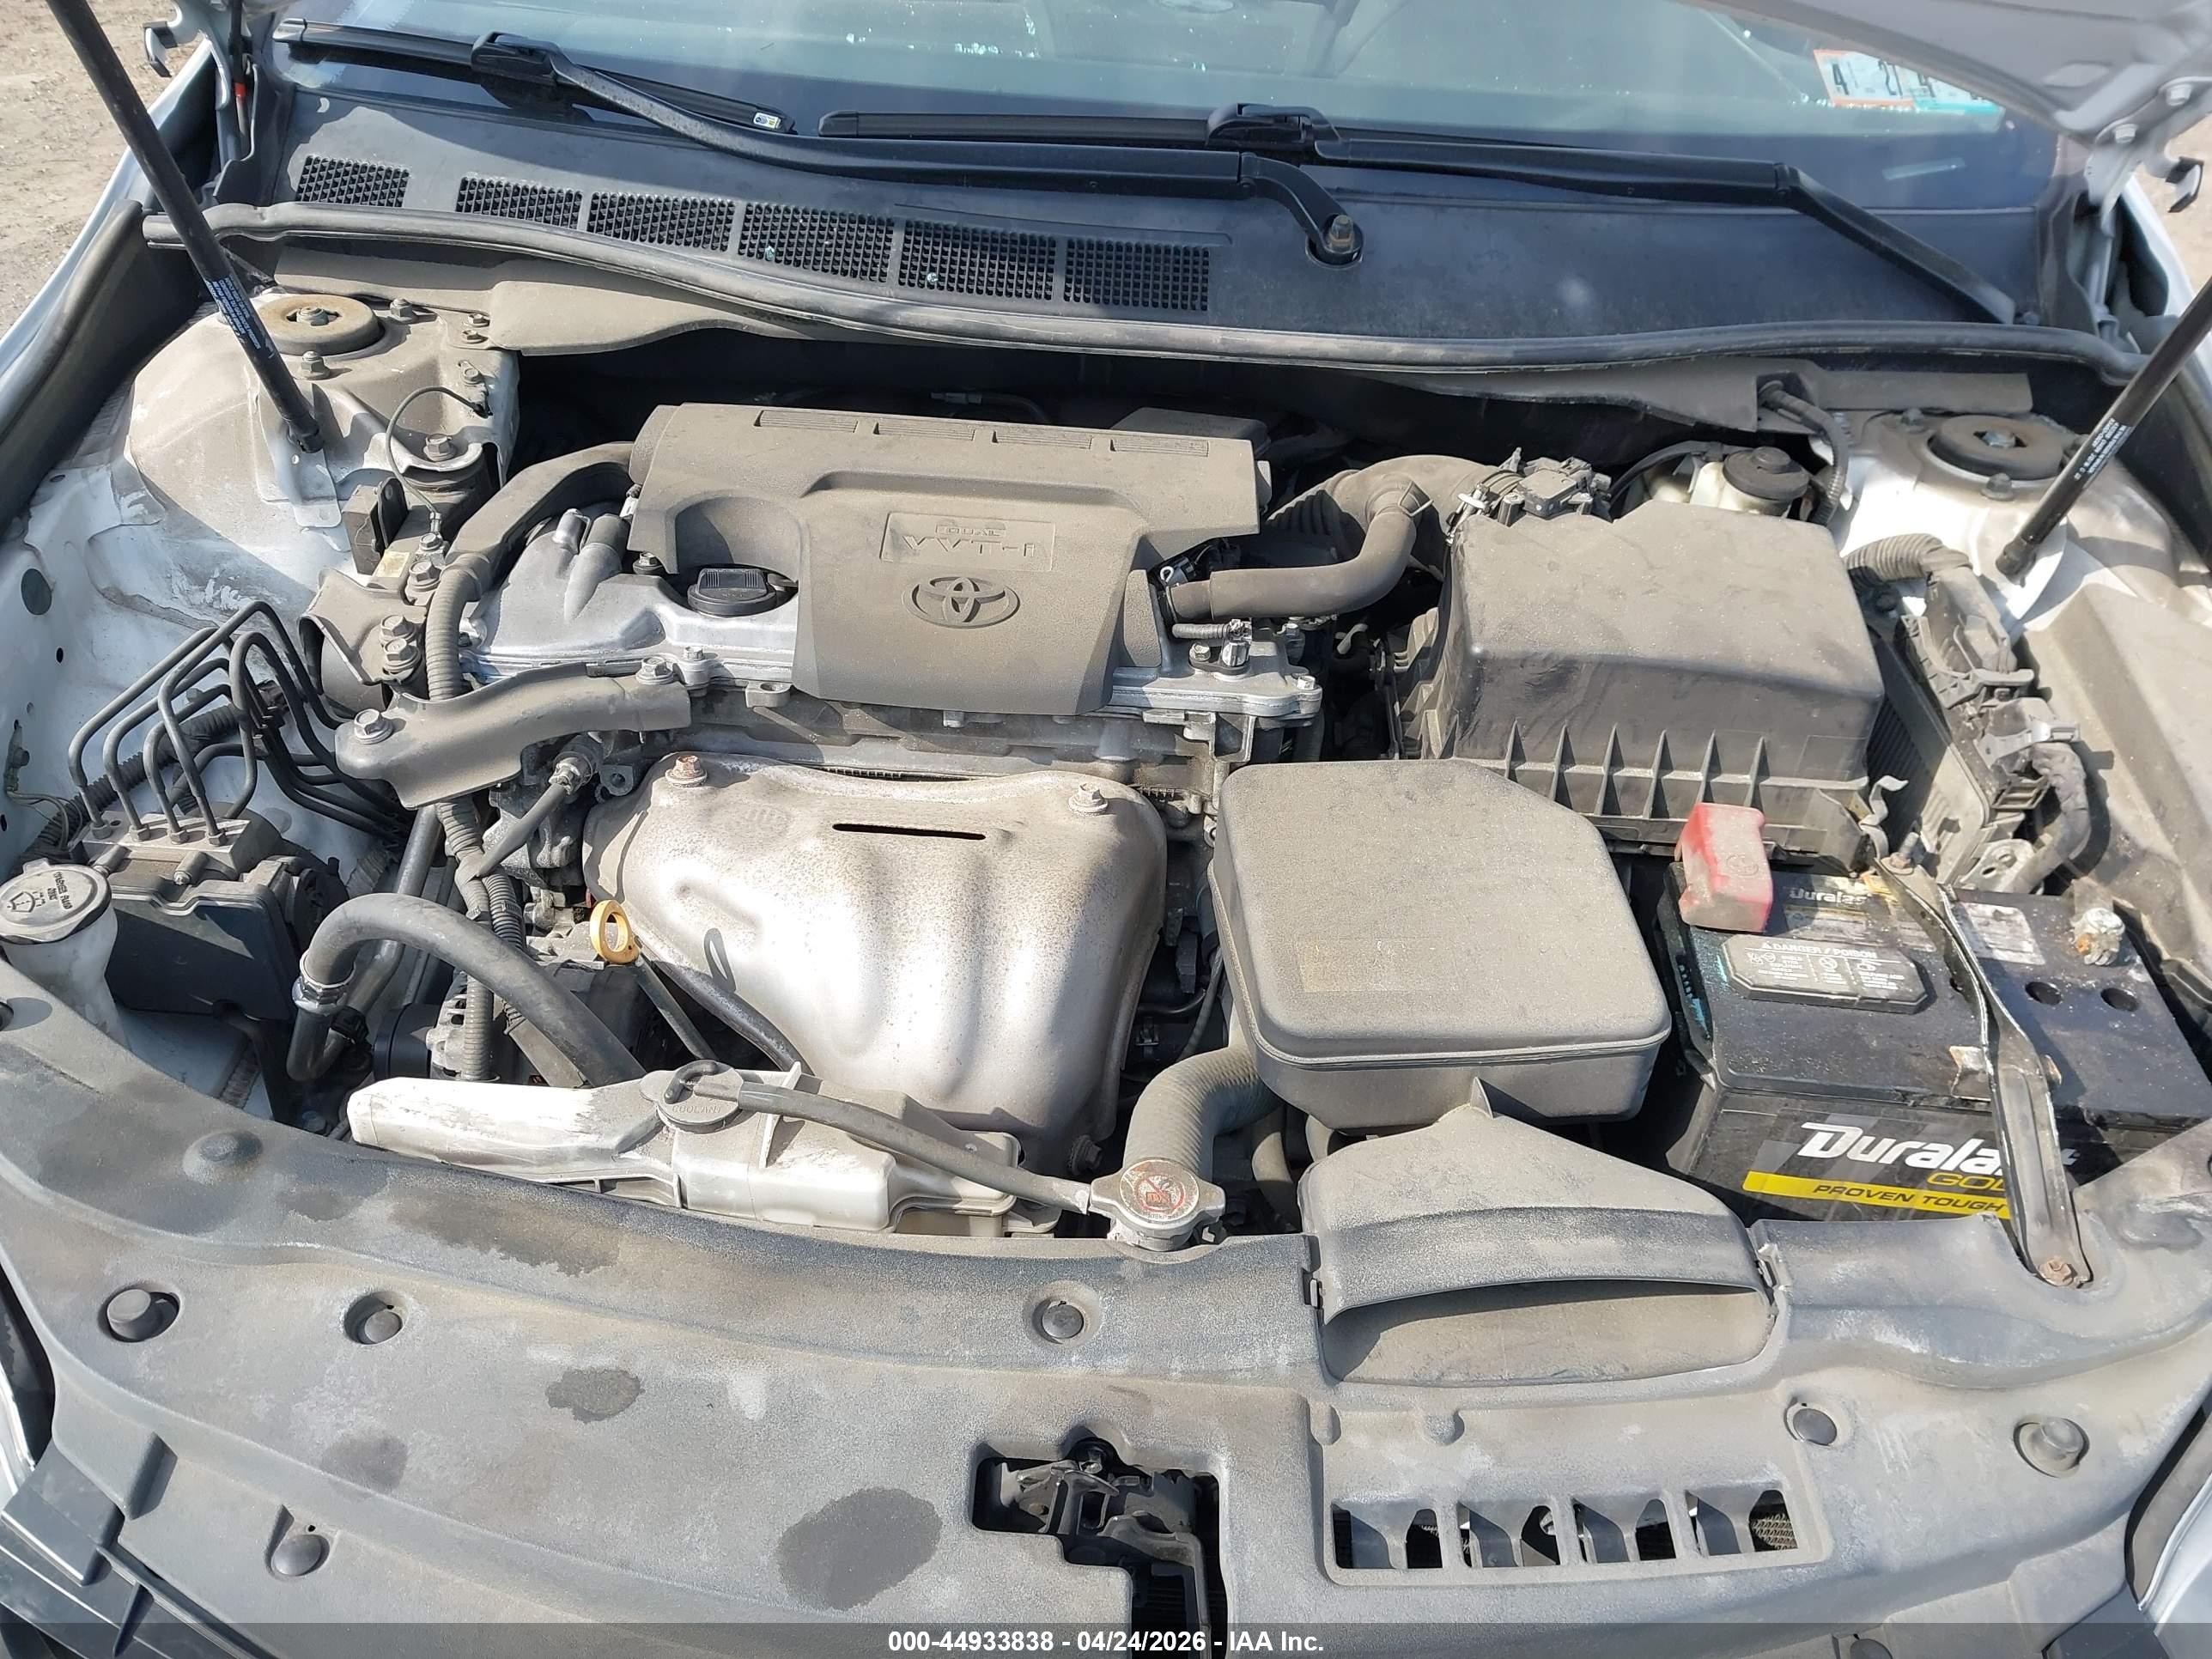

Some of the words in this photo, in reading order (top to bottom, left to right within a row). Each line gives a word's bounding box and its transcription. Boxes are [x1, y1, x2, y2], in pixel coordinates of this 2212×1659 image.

[1771, 942, 1822, 954] DANGER
[1832, 947, 1878, 959] POISON
[672, 1104, 722, 1115] COOLANT
[1926, 1171, 2006, 1192] GOL
[1813, 1184, 1915, 1203] PROVEN
[1923, 1195, 2007, 1212] TOUGH
